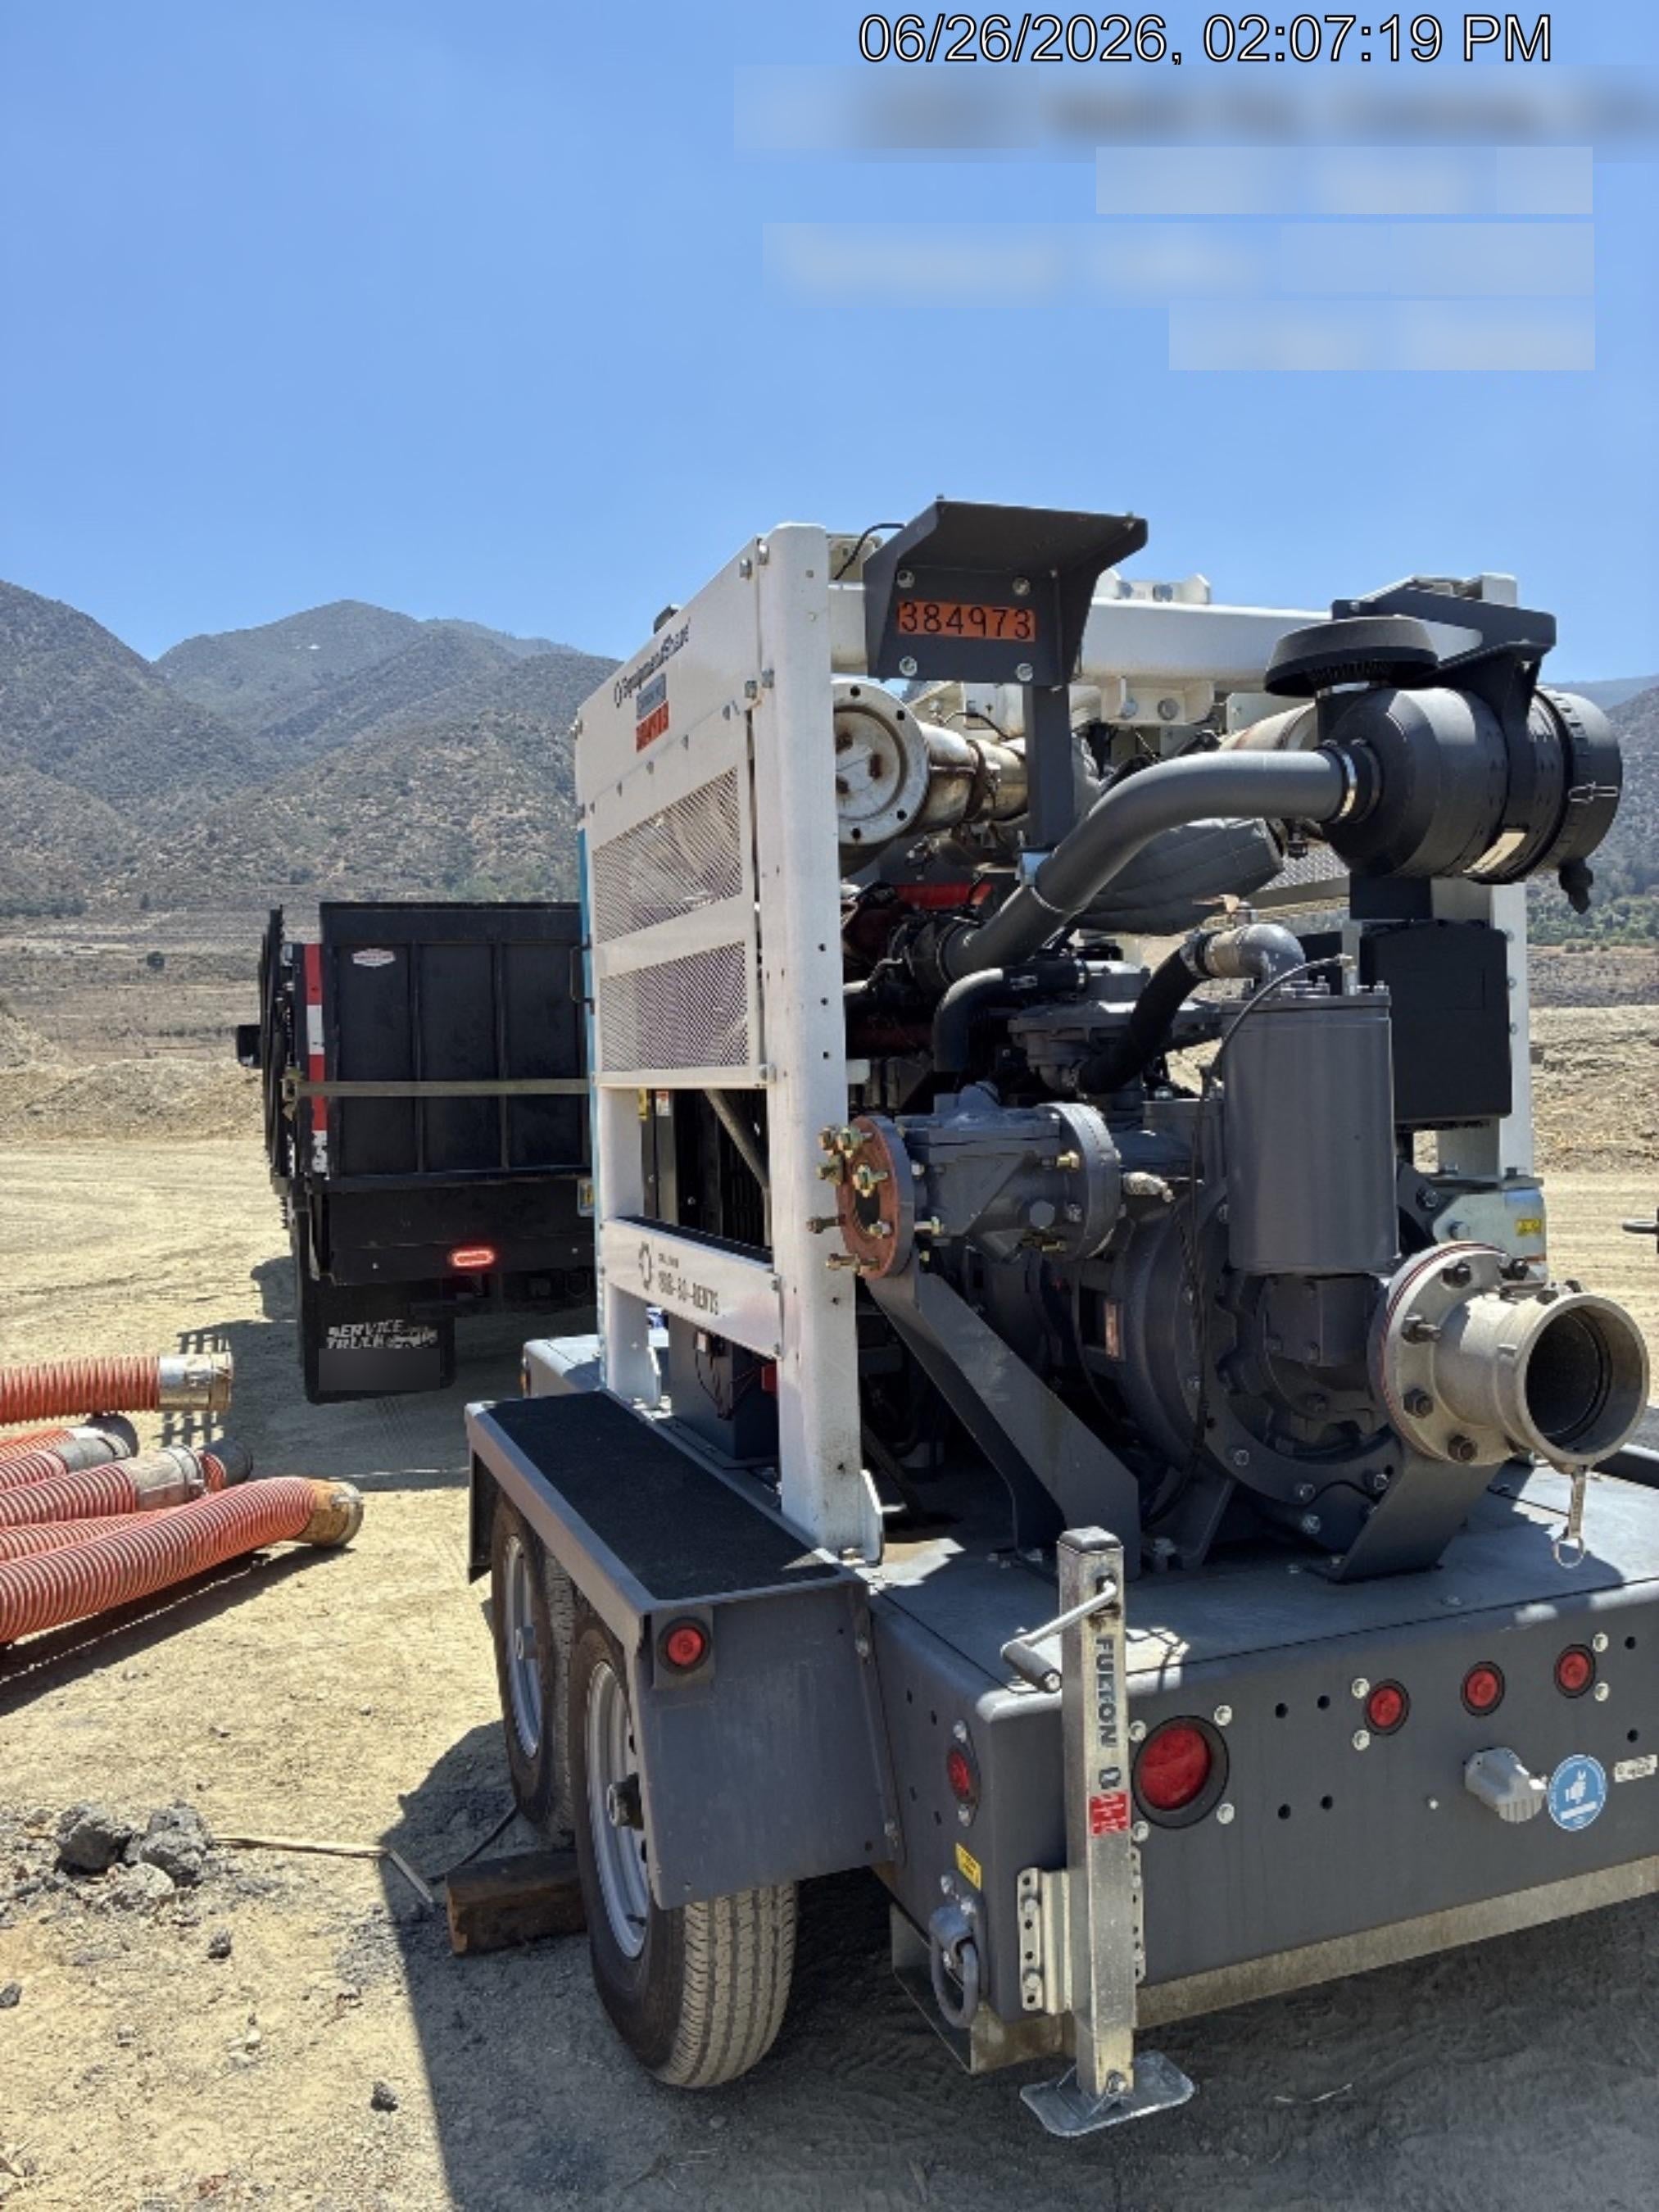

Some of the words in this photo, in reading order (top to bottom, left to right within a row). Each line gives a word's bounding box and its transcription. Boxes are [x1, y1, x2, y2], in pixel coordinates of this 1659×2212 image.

[901, 601, 1031, 640] 384973
[328, 1318, 405, 1336] SERVICE
[1095, 1638, 1118, 1749] FULTON
